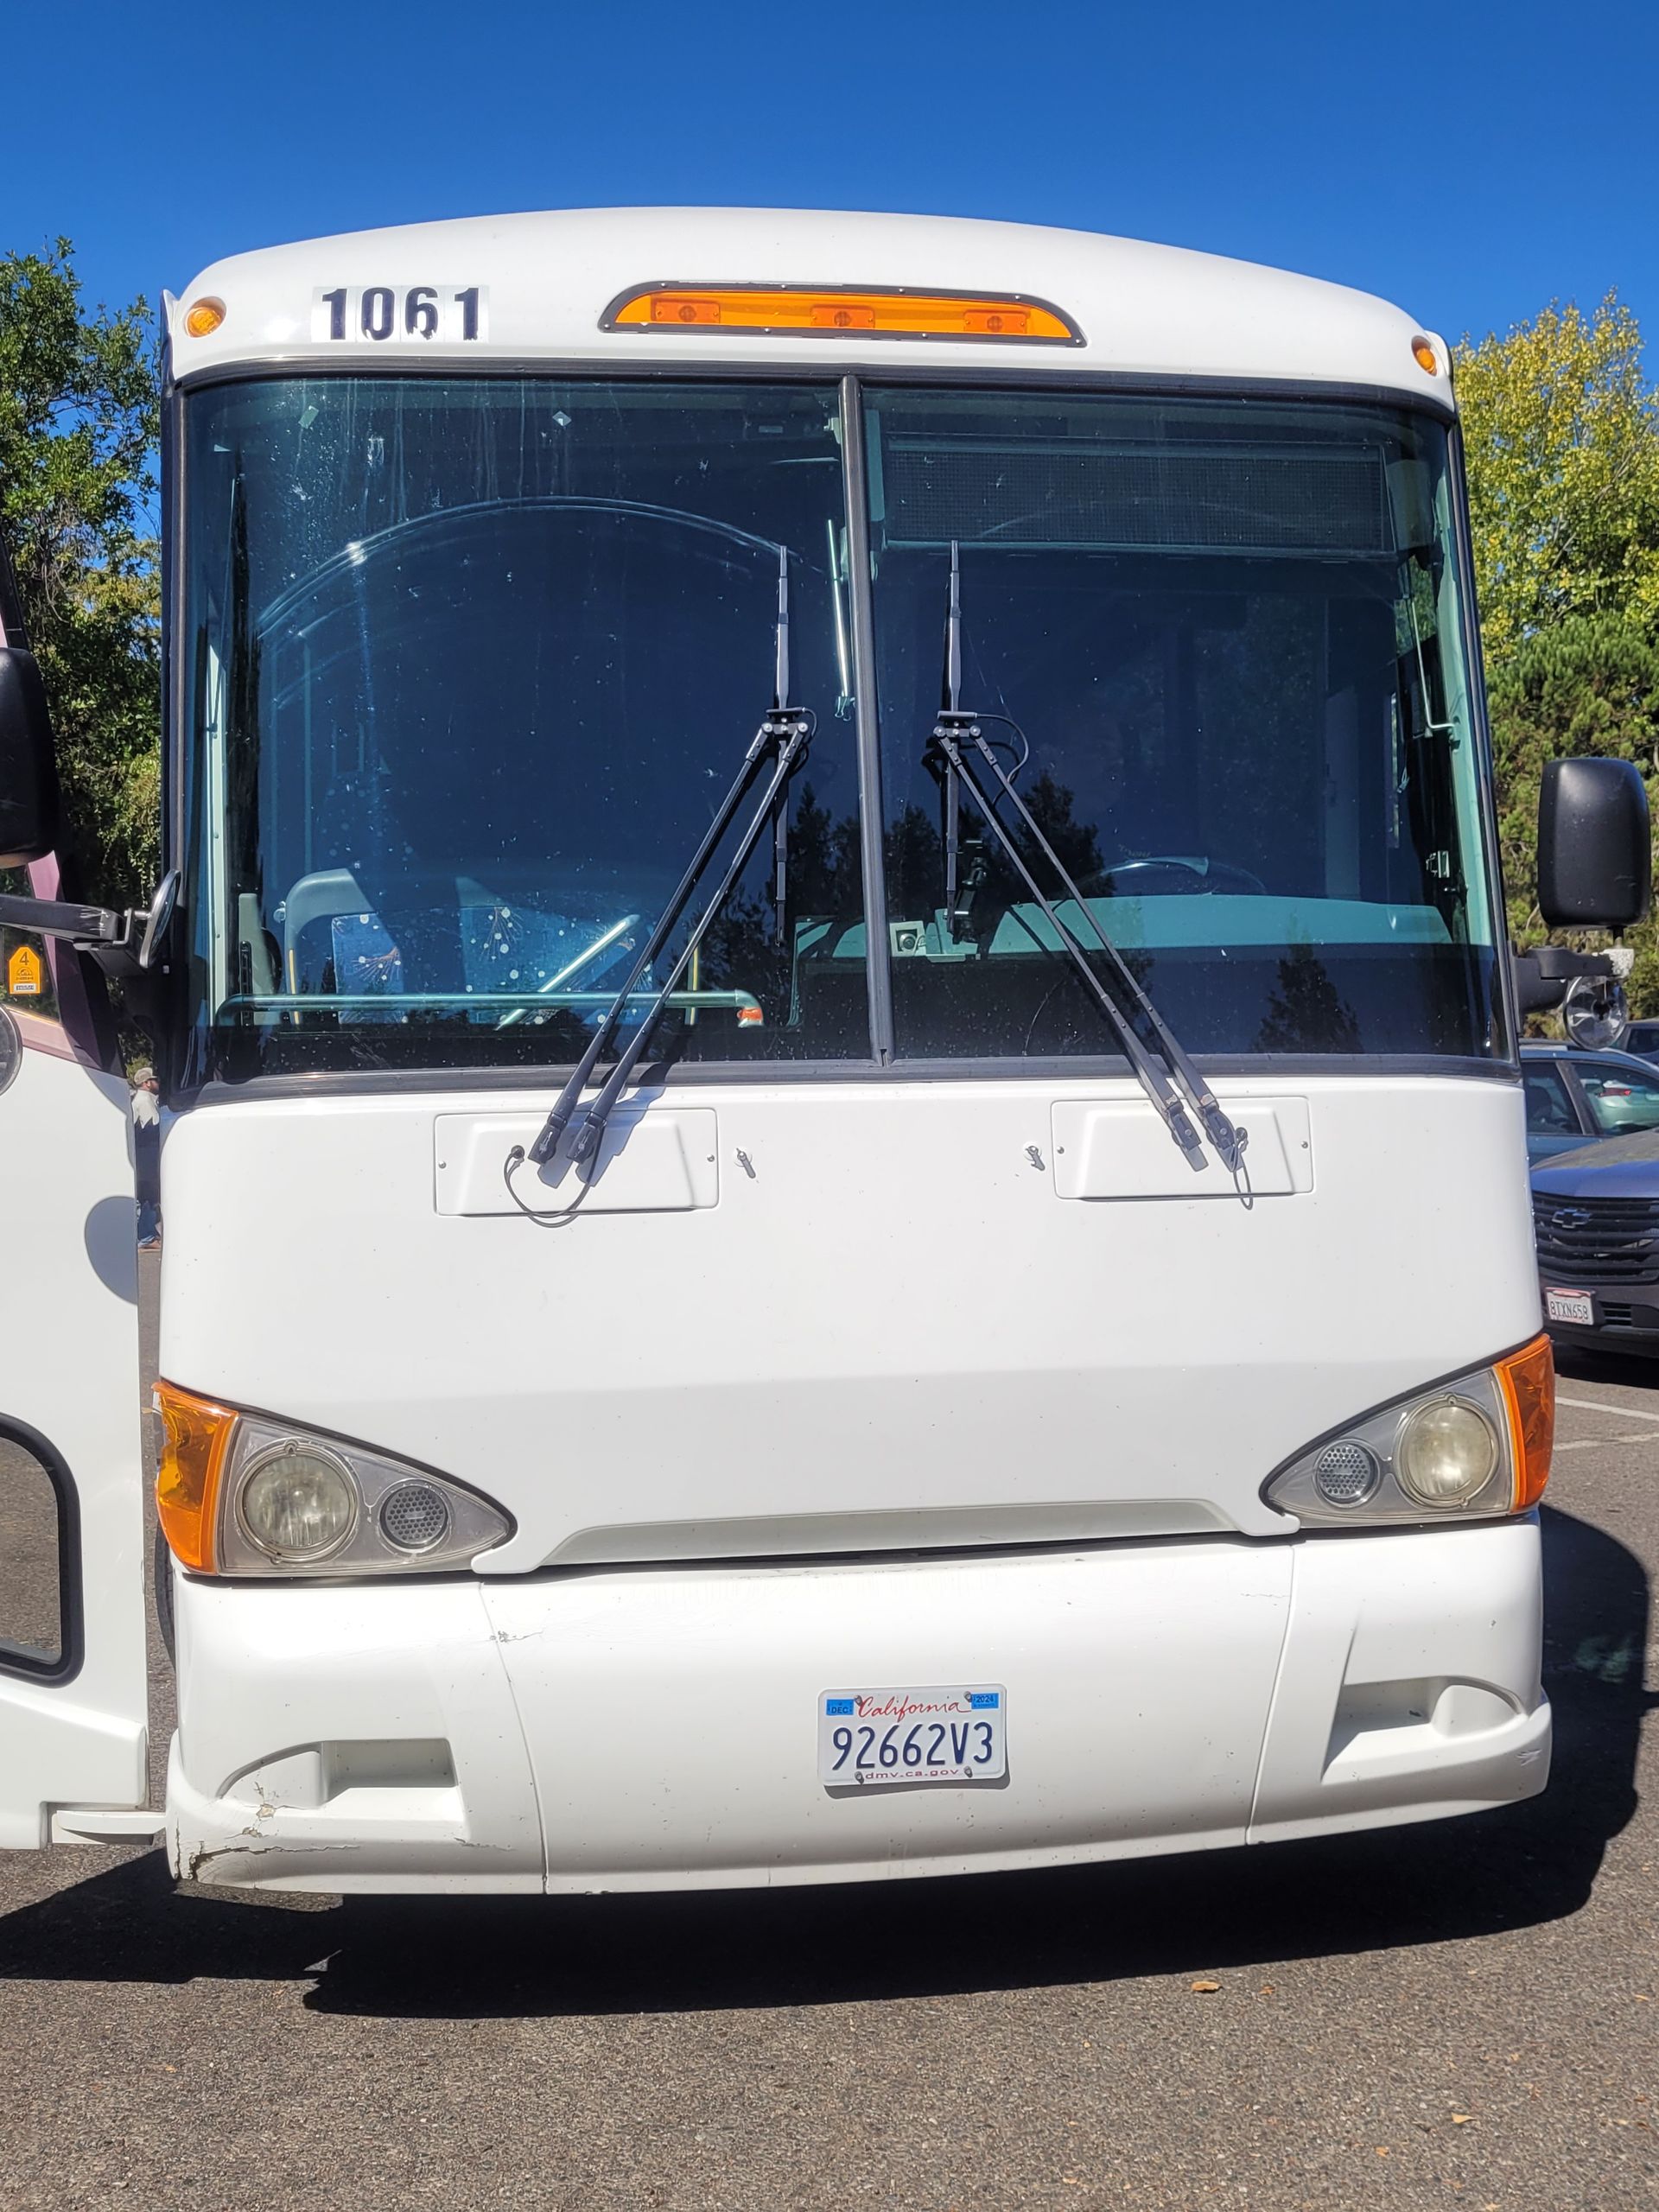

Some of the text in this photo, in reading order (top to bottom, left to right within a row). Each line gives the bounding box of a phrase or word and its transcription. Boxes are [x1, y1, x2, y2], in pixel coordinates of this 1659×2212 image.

[322, 287, 479, 340] 1061
[19, 951, 29, 965] 4
[1549, 1300, 1588, 1320] 8TXN658
[858, 1694, 971, 1722] California
[976, 1694, 994, 1703] 2024
[832, 1721, 993, 1770] 92662V3
[865, 1768, 959, 1780] dmv.ca.gov
